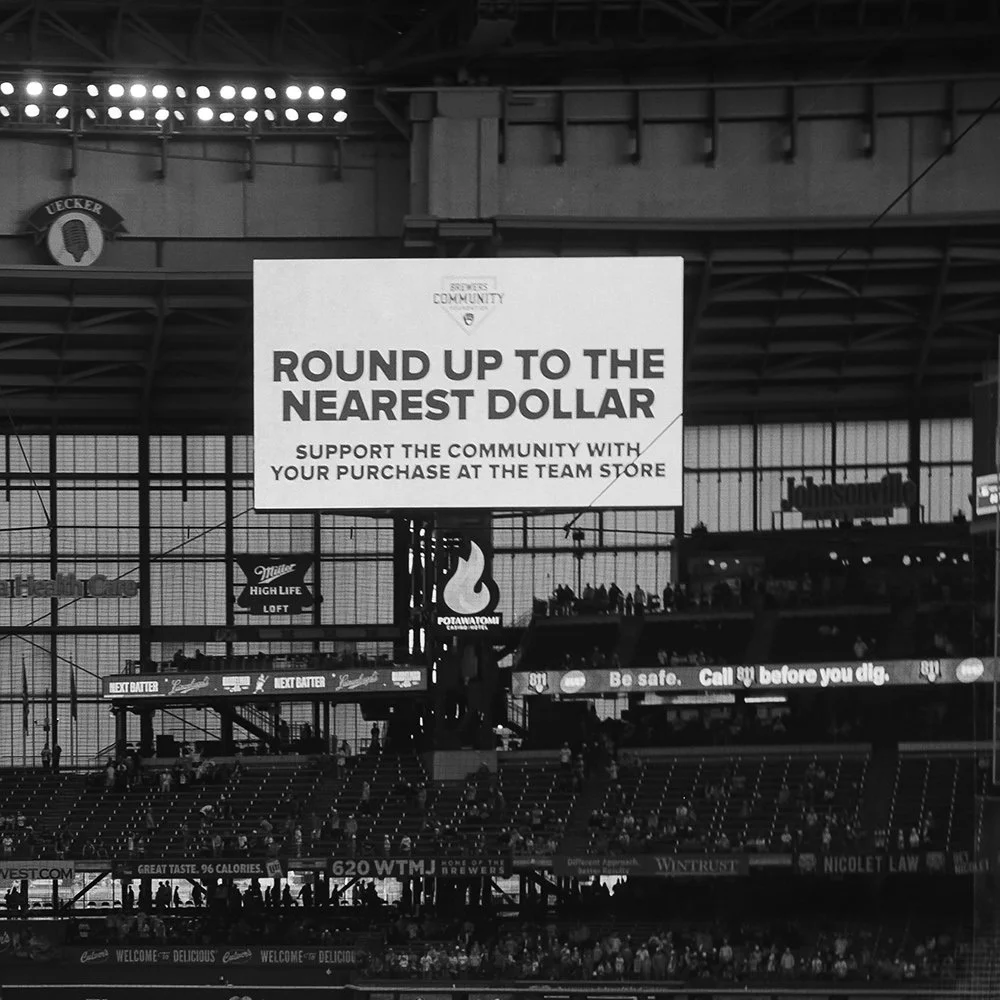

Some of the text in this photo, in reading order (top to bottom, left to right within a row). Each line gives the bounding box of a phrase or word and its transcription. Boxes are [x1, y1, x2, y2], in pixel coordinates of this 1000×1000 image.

[45, 198, 104, 217] UECKER
[433, 293, 504, 304] COMMUNITY
[273, 348, 665, 382] ROUND UP TO THE
[282, 388, 655, 421] NEAREST DOLLAR
[296, 442, 641, 460] SUPPORT THE COMMUNITY WITH
[271, 463, 666, 481] YOUR PURCHASE AT THE TEAM STORE
[254, 563, 296, 584] Miller
[13, 572, 83, 598] Health
[88, 574, 140, 598] Care
[250, 586, 303, 596] HIGH LIFE
[263, 605, 289, 613] LOFT
[437, 616, 500, 625] POTAWATOMI
[274, 677, 295, 689] NEXT
[296, 676, 325, 688] BATTER
[610, 669, 682, 687] Be safe.
[700, 662, 889, 687] Call before you dig.
[109, 682, 129, 693] NEXT
[130, 681, 159, 693] BATTER
[138, 864, 168, 874] GREAT
[169, 864, 199, 874] TASTE.
[201, 864, 214, 874] 96
[216, 863, 264, 874] CALORIES.
[332, 860, 436, 876] 620 WTMJ
[654, 857, 740, 873] WINTRUST
[824, 855, 920, 873] NICOLET LAW
[116, 950, 157, 962] WELCOME
[173, 950, 215, 963] DELICIOUS
[260, 950, 303, 963] WELCOME
